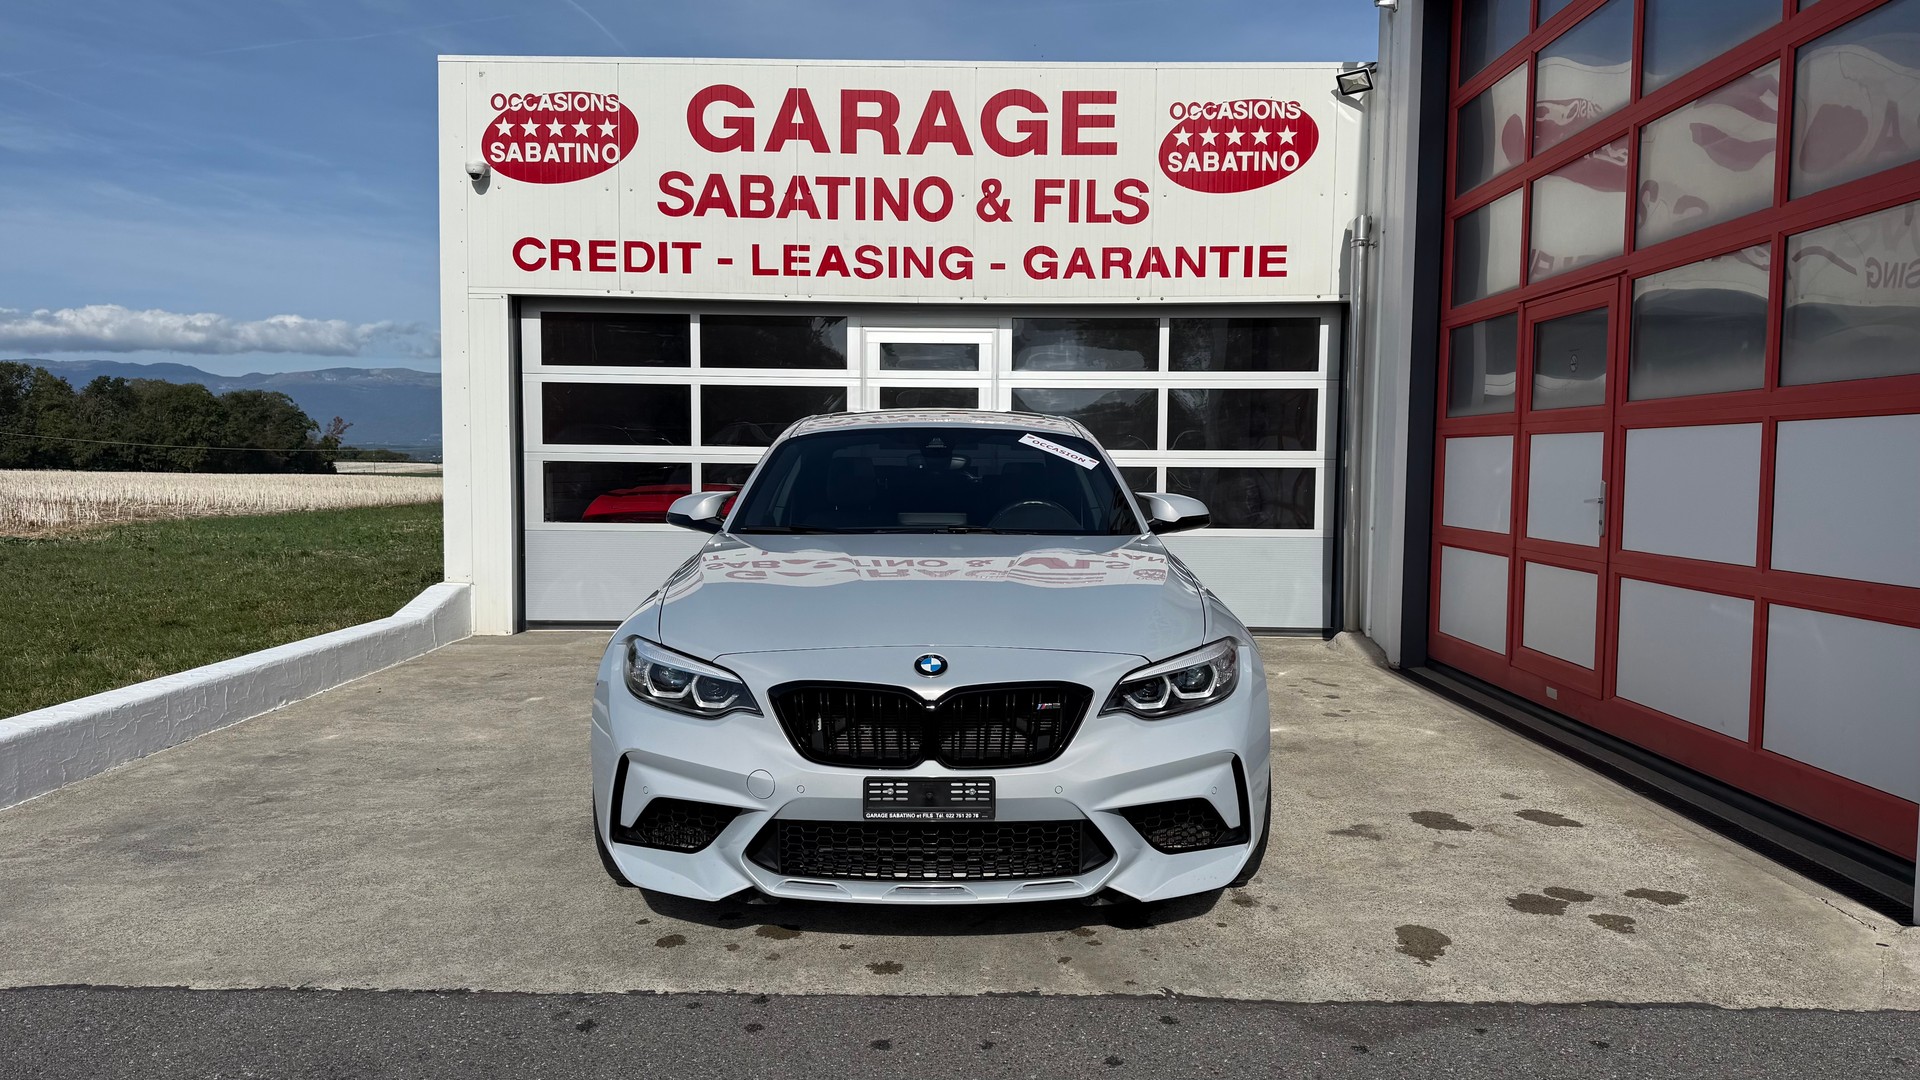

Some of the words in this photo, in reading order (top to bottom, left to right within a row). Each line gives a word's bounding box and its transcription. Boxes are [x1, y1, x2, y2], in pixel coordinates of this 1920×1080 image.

[490, 93, 620, 112] OCCASIONS
[1169, 100, 1302, 121] OCCASIONS
[687, 84, 1118, 158] GARAGE
[490, 142, 620, 164] SABATINO
[1167, 150, 1301, 173] SABATINO
[657, 171, 954, 223] SABATINO
[976, 178, 1012, 223] &
[1034, 178, 1150, 225] FILS
[512, 237, 702, 274] CREDIT
[752, 244, 974, 281] LEASING
[1023, 245, 1288, 280] GARANTIE
[1032, 439, 1086, 463] OCCASION
